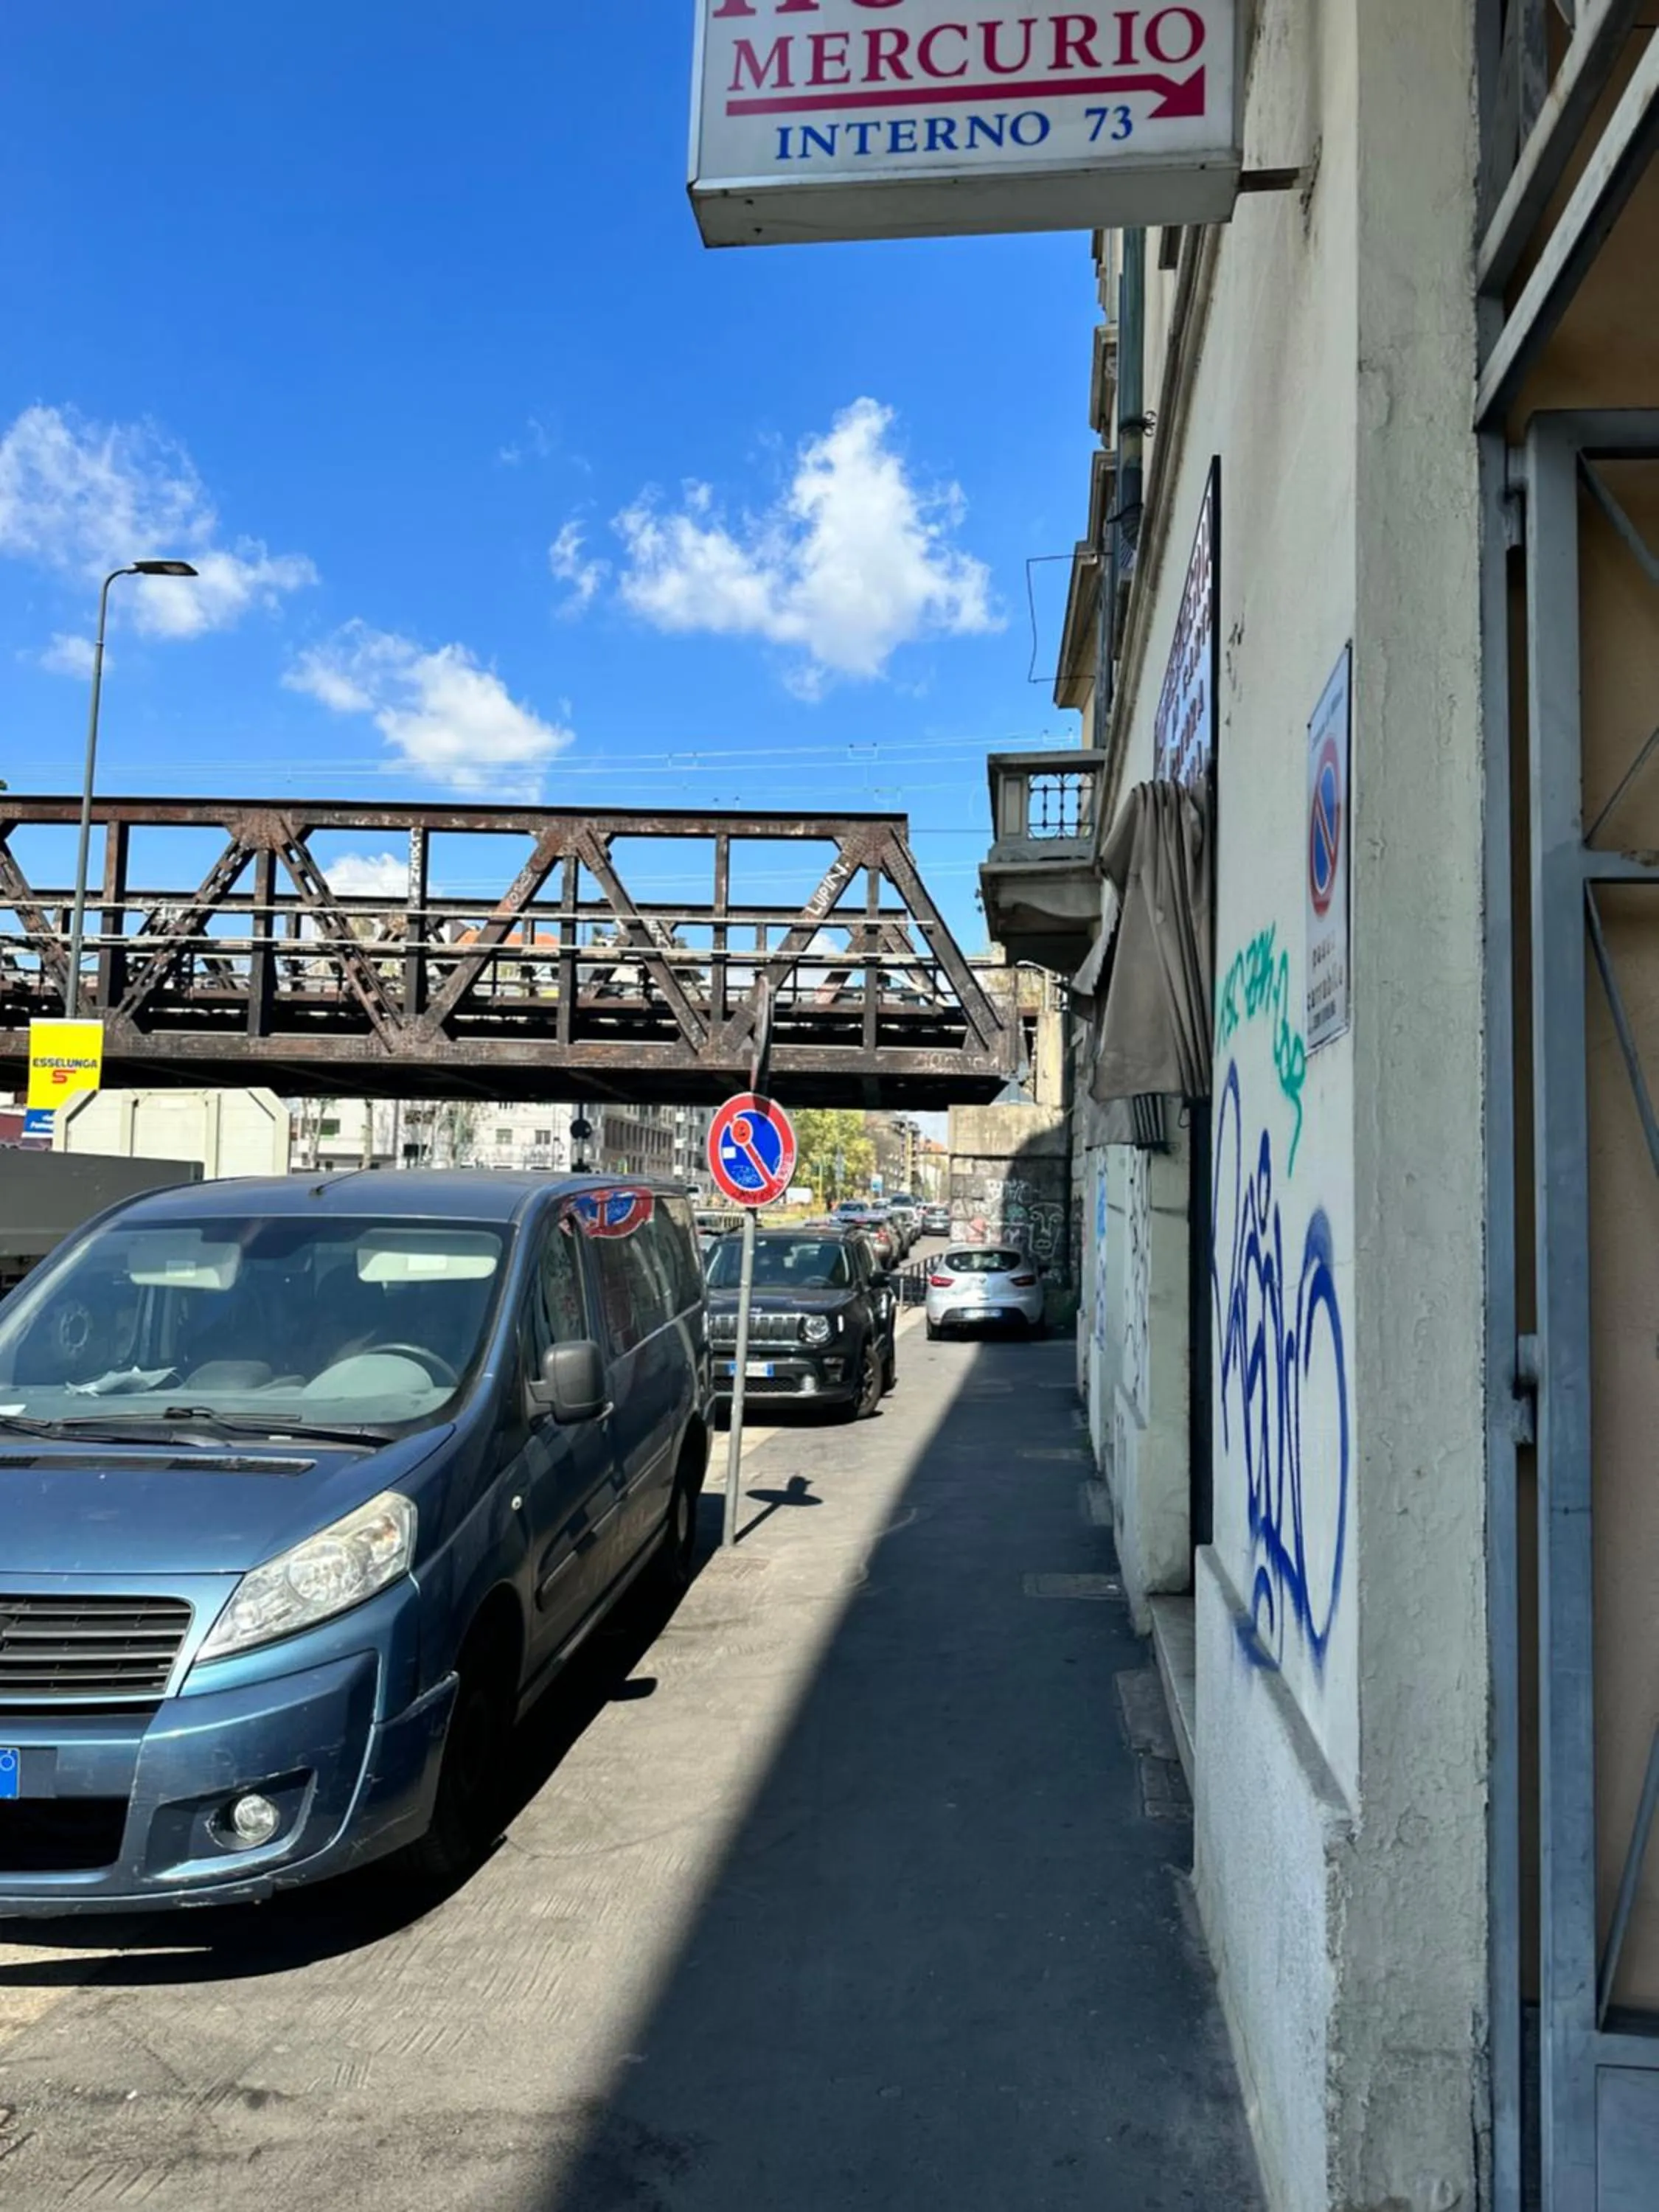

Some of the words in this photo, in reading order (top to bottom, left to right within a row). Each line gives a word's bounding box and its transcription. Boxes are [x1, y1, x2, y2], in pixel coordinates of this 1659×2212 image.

[726, 7, 1206, 92] MERCURIO
[774, 110, 1051, 161] INTERNO
[1084, 105, 1135, 144] 73
[32, 1057, 98, 1068] ESSELUNGA
